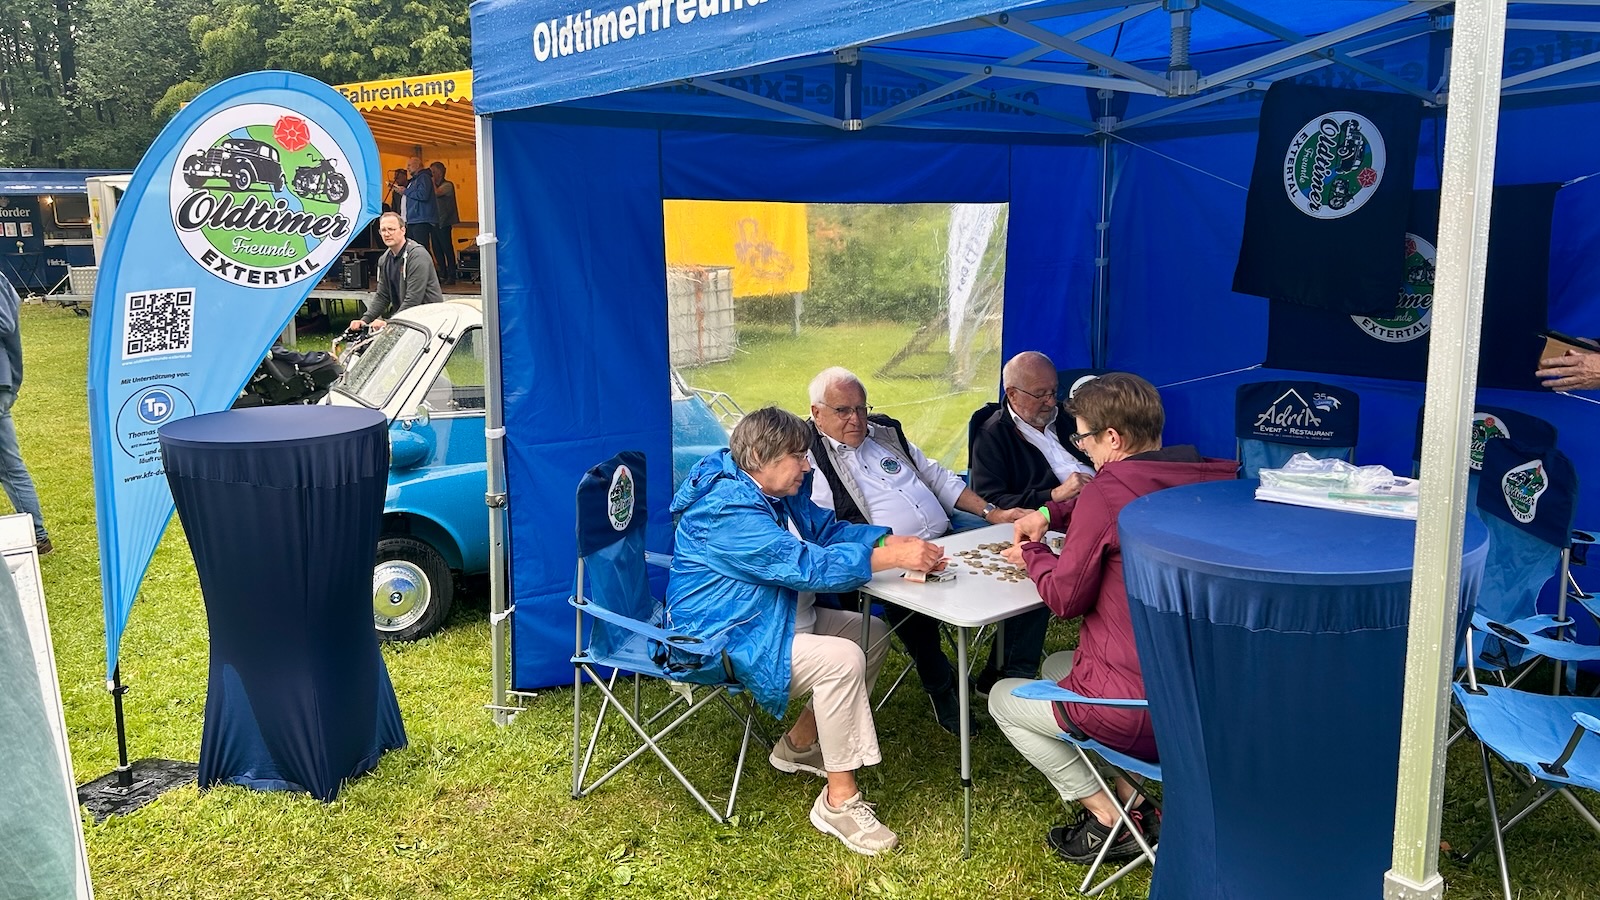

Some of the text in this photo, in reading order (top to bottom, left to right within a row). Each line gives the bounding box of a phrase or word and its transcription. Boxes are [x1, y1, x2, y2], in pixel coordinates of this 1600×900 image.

[1287, 132, 1309, 198] EXTERTAL
[1299, 147, 1313, 183] Freunde
[1308, 118, 1340, 212] Oldtimer
[177, 191, 349, 239] Oldtimer
[232, 236, 297, 258] Freunde
[200, 249, 320, 285] EXTERTAL
[1362, 318, 1428, 338] EXTERTAL
[132, 373, 176, 383] Unterstützung
[1312, 393, 1327, 401] 35
[128, 429, 156, 439] Thomas
[124, 468, 166, 483] www.kfz-du
